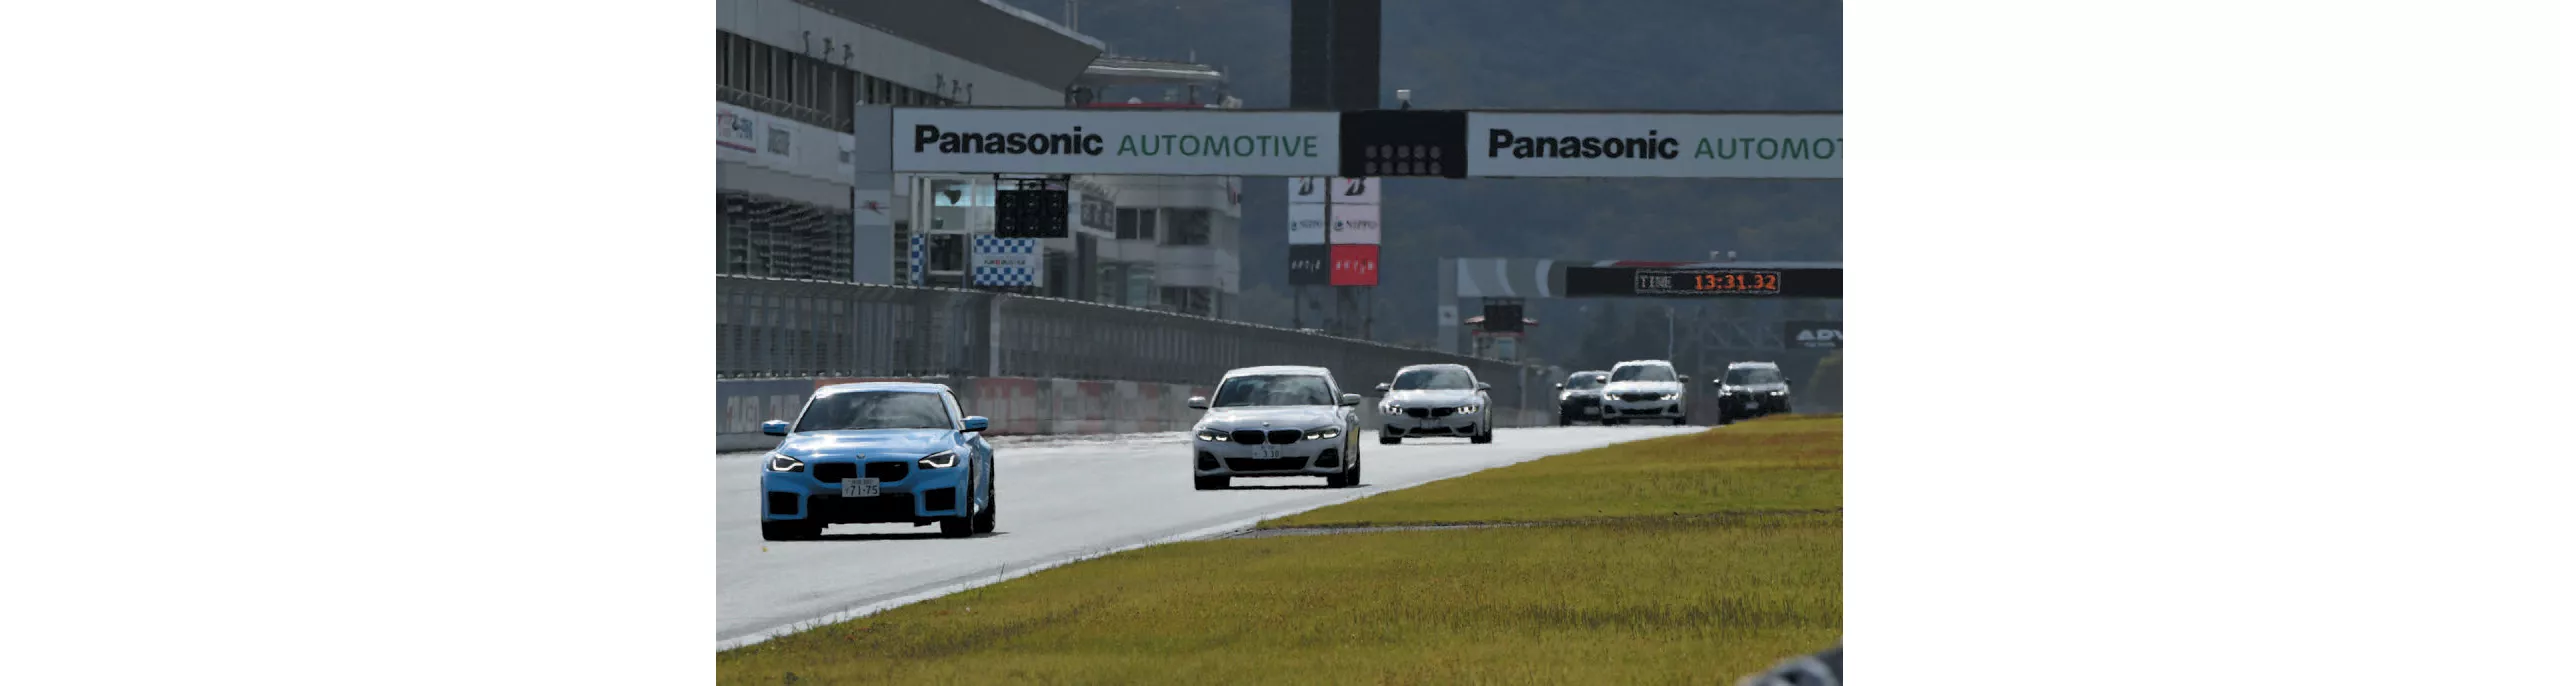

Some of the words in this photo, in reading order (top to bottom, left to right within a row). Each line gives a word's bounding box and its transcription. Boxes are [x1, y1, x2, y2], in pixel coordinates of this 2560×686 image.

[913, 125, 1103, 154] Panasonic
[1117, 135, 1318, 156] AUTOMOTIVE
[1489, 129, 1679, 159] Panasonic
[1695, 274, 1777, 290] 13:31.32
